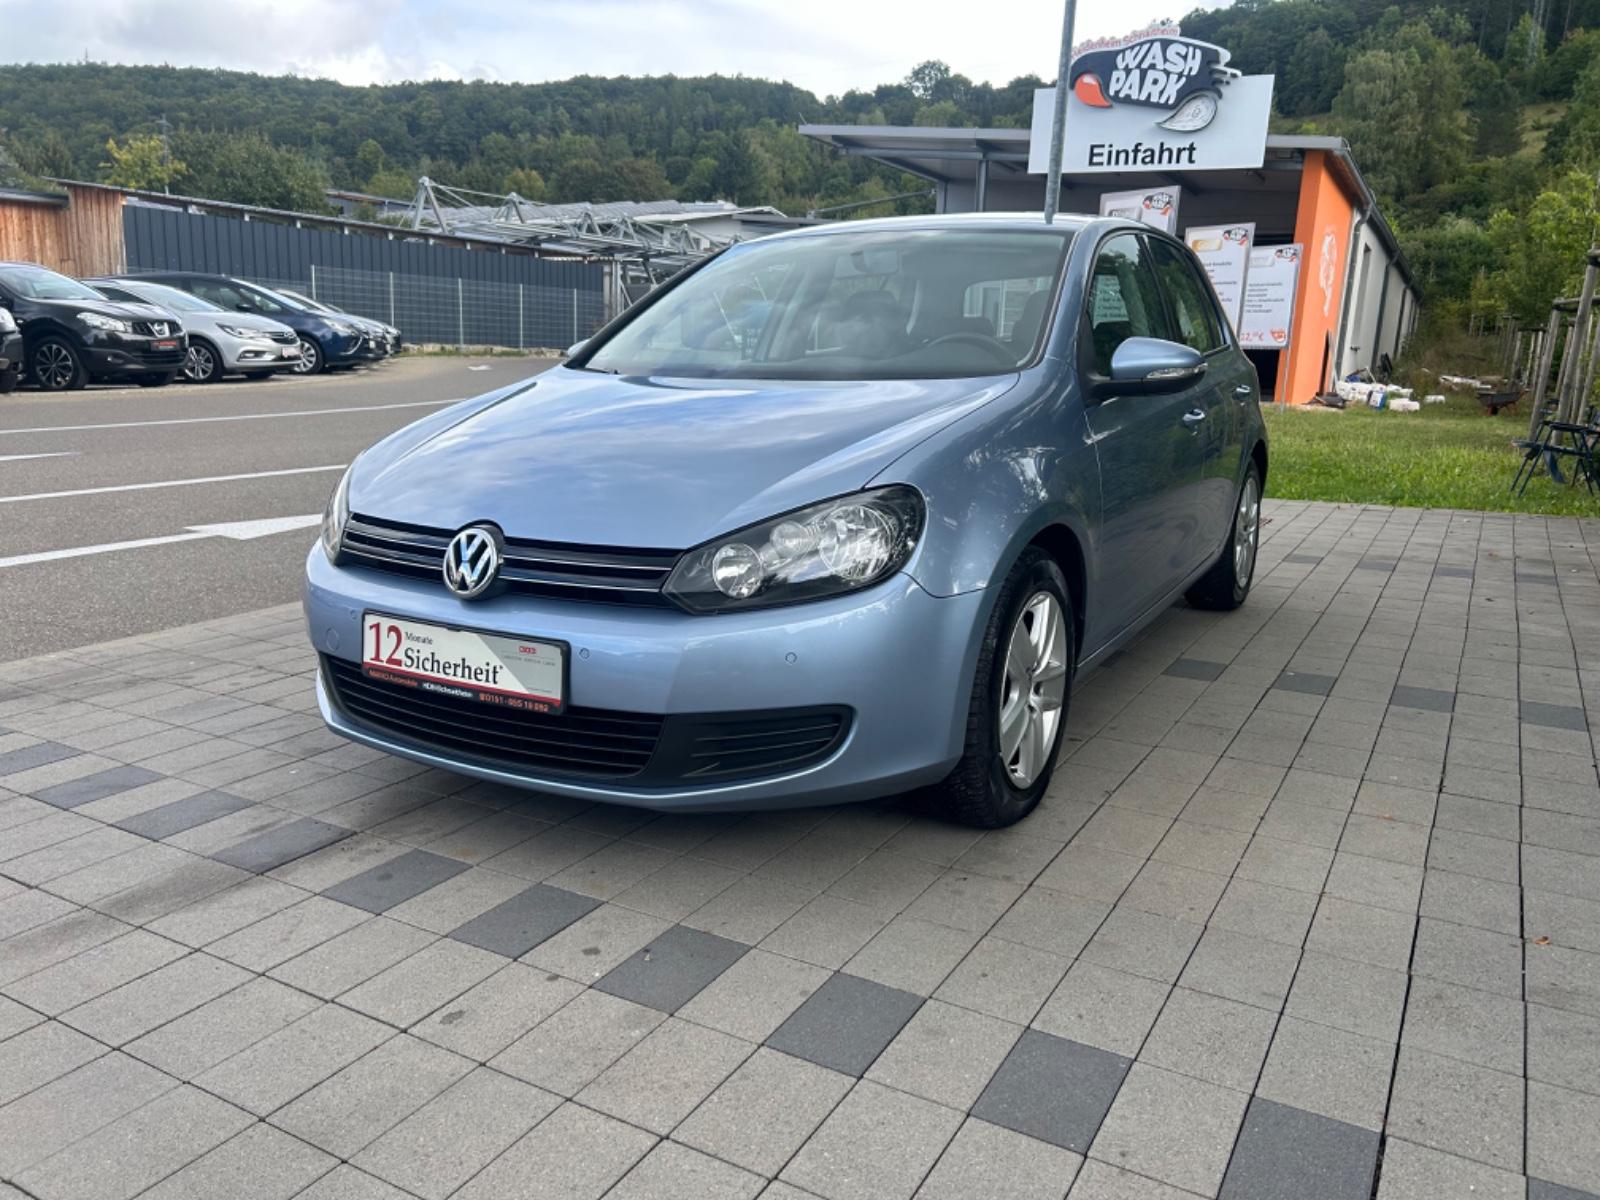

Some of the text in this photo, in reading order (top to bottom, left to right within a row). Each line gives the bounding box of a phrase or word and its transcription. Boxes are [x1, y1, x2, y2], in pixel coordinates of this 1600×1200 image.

[1115, 41, 1202, 76] WASH
[1108, 68, 1187, 105] PARK
[1088, 141, 1196, 167] Einfahrt
[369, 622, 403, 668] 12
[404, 631, 434, 646] Monate
[404, 646, 500, 686] Sicherheit
